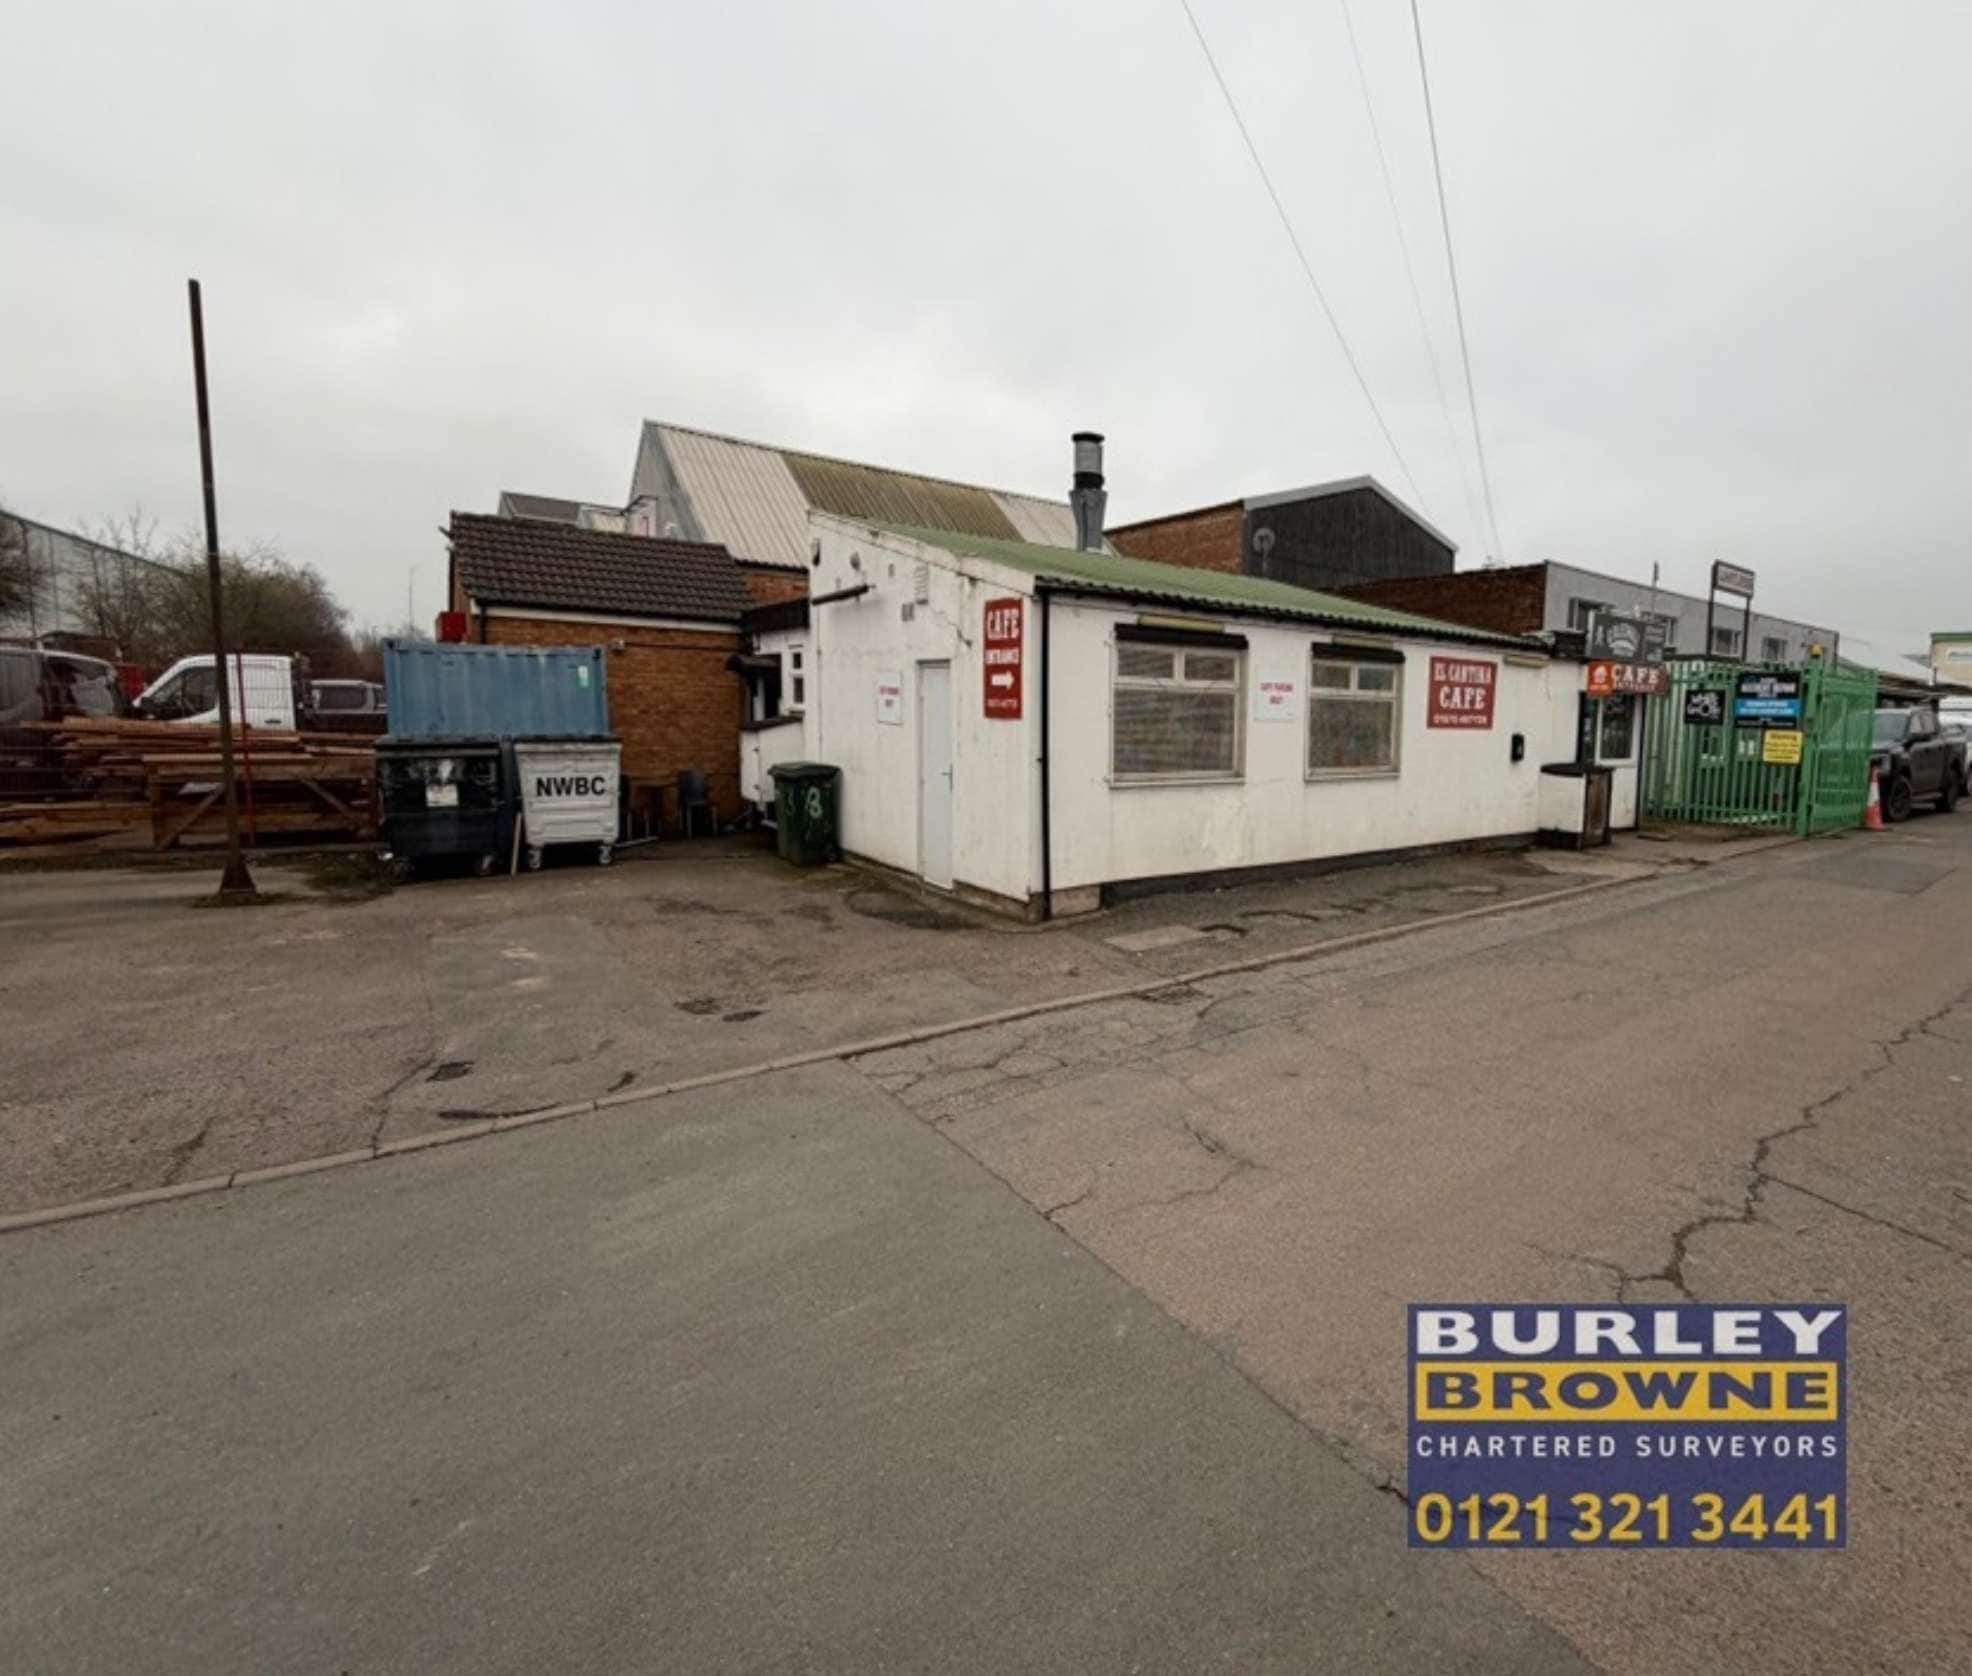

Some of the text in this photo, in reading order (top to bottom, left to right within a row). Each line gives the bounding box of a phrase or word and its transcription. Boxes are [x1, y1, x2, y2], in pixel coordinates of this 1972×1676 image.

[986, 607, 1020, 640] CAFE
[1611, 663, 1660, 685] CAFE
[1439, 685, 1487, 711] CAFE
[536, 776, 606, 797] NWBC
